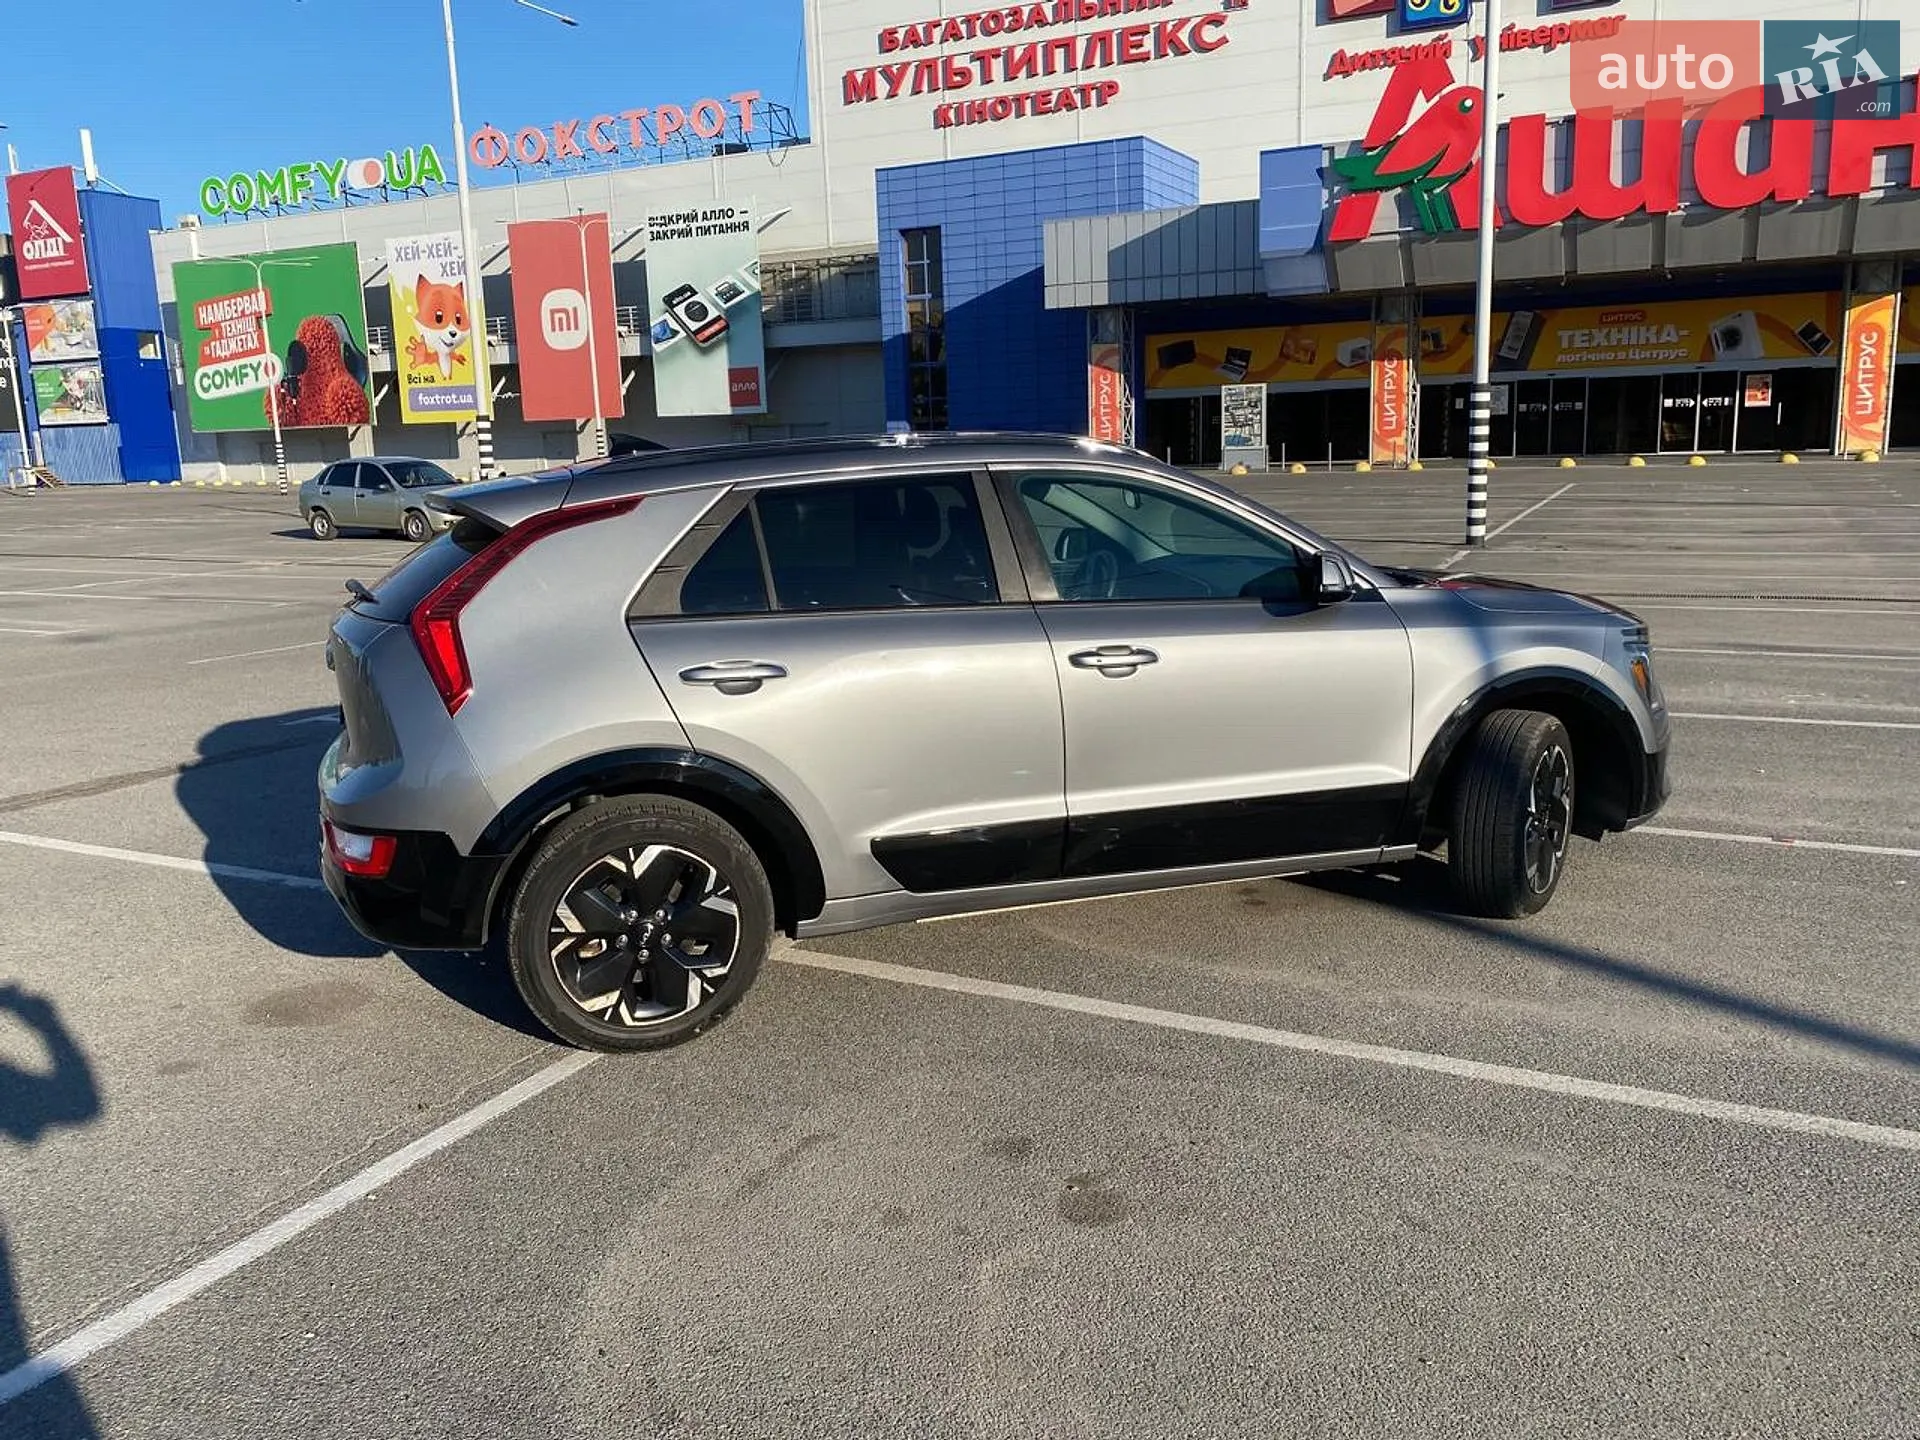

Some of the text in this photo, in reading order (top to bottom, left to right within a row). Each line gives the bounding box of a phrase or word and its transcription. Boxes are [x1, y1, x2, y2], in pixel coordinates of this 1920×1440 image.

[842, 12, 1231, 105] МУЛЬТИПЛЕКС
[1323, 33, 1453, 80] Дитячий
[933, 80, 1121, 129] КІНОТЕАТР
[469, 90, 761, 168] ФОКСТРОТ
[200, 143, 447, 216] COMFY UA
[649, 220, 750, 241] ЗАКРИЙ ПИТАННЯ
[702, 207, 735, 222] АЛЛО
[440, 256, 467, 278] ХЕЙ
[210, 331, 260, 359] ГАДЖЕТАХ
[199, 360, 262, 394] COMFY
[1383, 352, 1399, 431] ЦИТРУС
[1855, 331, 1879, 416] ЦИТРУС
[418, 391, 475, 406] foxtrot.ua
[1099, 373, 1114, 441] ЦИТРУС
